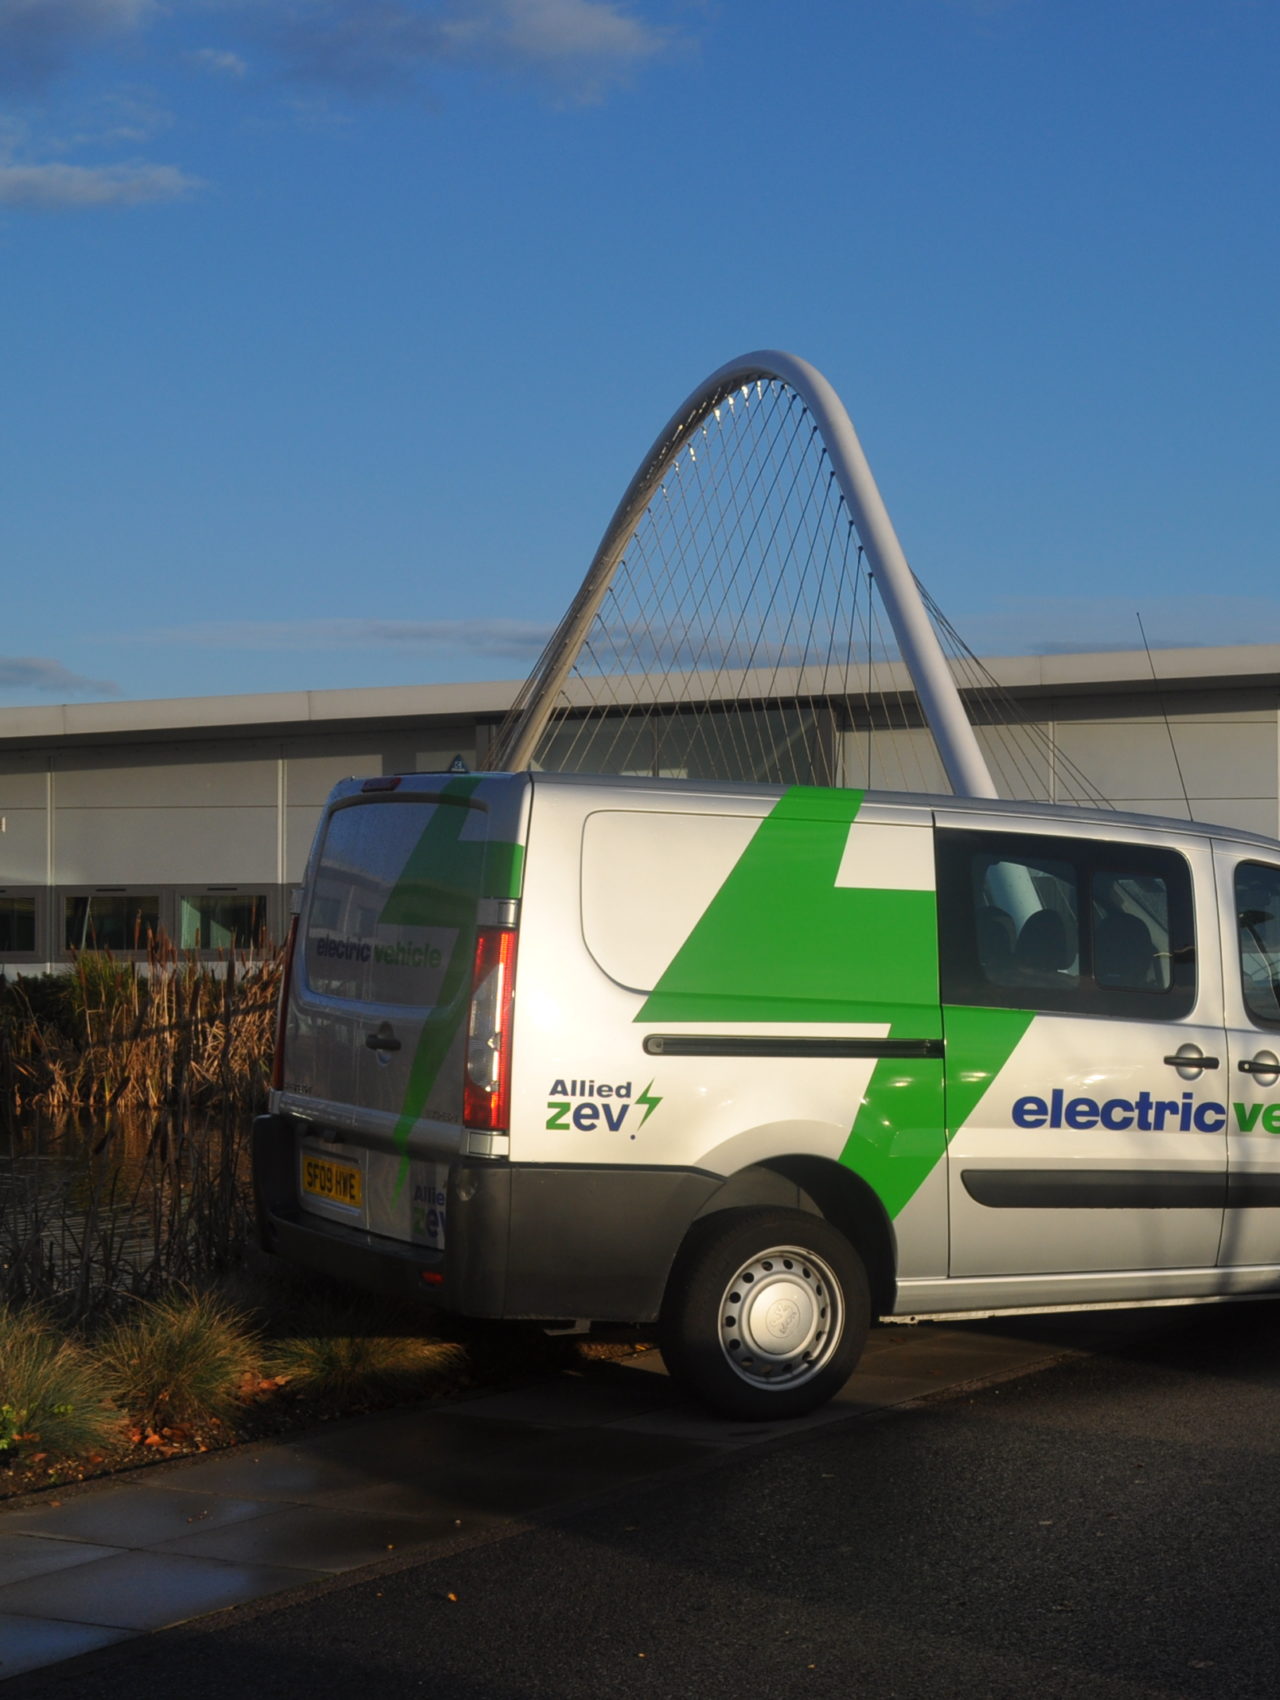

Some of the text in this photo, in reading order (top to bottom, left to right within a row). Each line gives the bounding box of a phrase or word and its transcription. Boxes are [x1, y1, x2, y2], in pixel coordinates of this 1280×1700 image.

[316, 932, 442, 968] electric vehicle
[548, 1079, 632, 1099] Allied
[1011, 1088, 1226, 1132] electric
[306, 1161, 333, 1193] SF09
